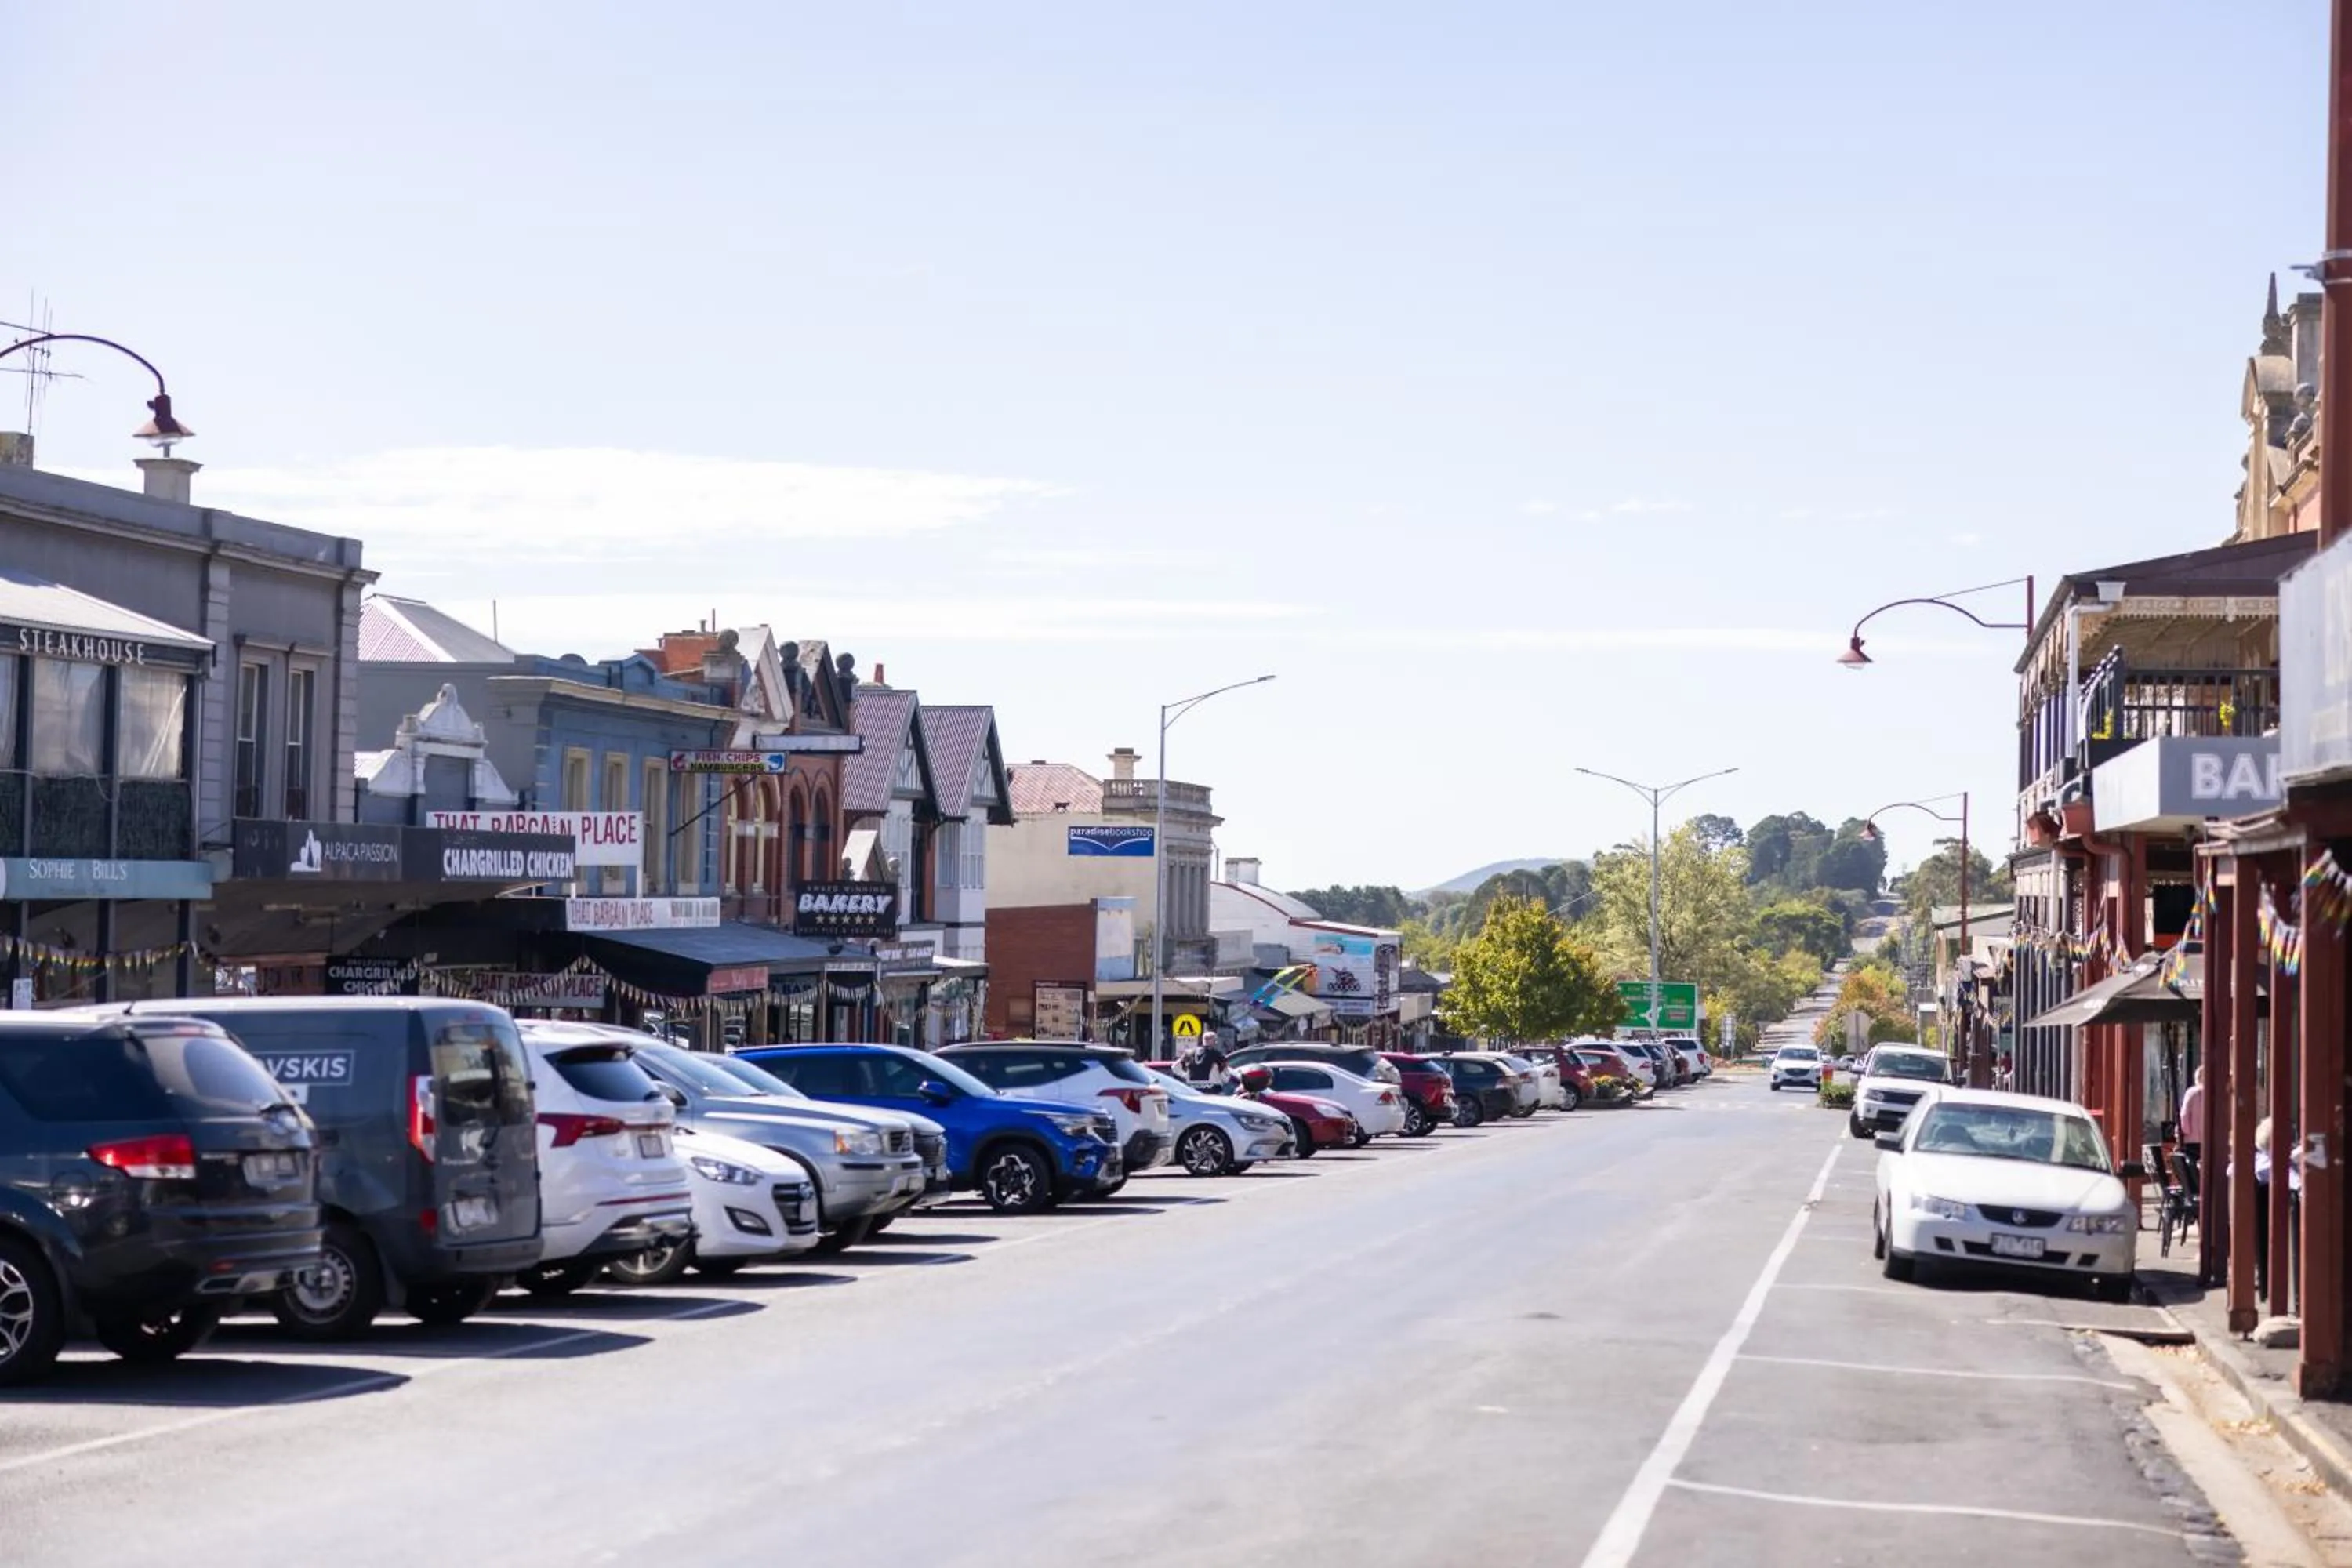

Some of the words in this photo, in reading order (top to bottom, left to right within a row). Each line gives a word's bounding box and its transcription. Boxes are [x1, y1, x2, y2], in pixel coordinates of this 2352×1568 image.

[19, 628, 146, 665] STEAKHOUSE
[690, 762, 764, 773] HAMBURGERS
[726, 753, 761, 763] CHIPS
[581, 815, 637, 844] PLACE
[1070, 827, 1153, 837] paradisebookshop
[28, 859, 76, 880] SOPHIE
[443, 848, 524, 877] CHARGRILLED
[527, 851, 574, 878] CHICKEN
[798, 894, 893, 913] BAKERY
[564, 978, 601, 997] PLACE
